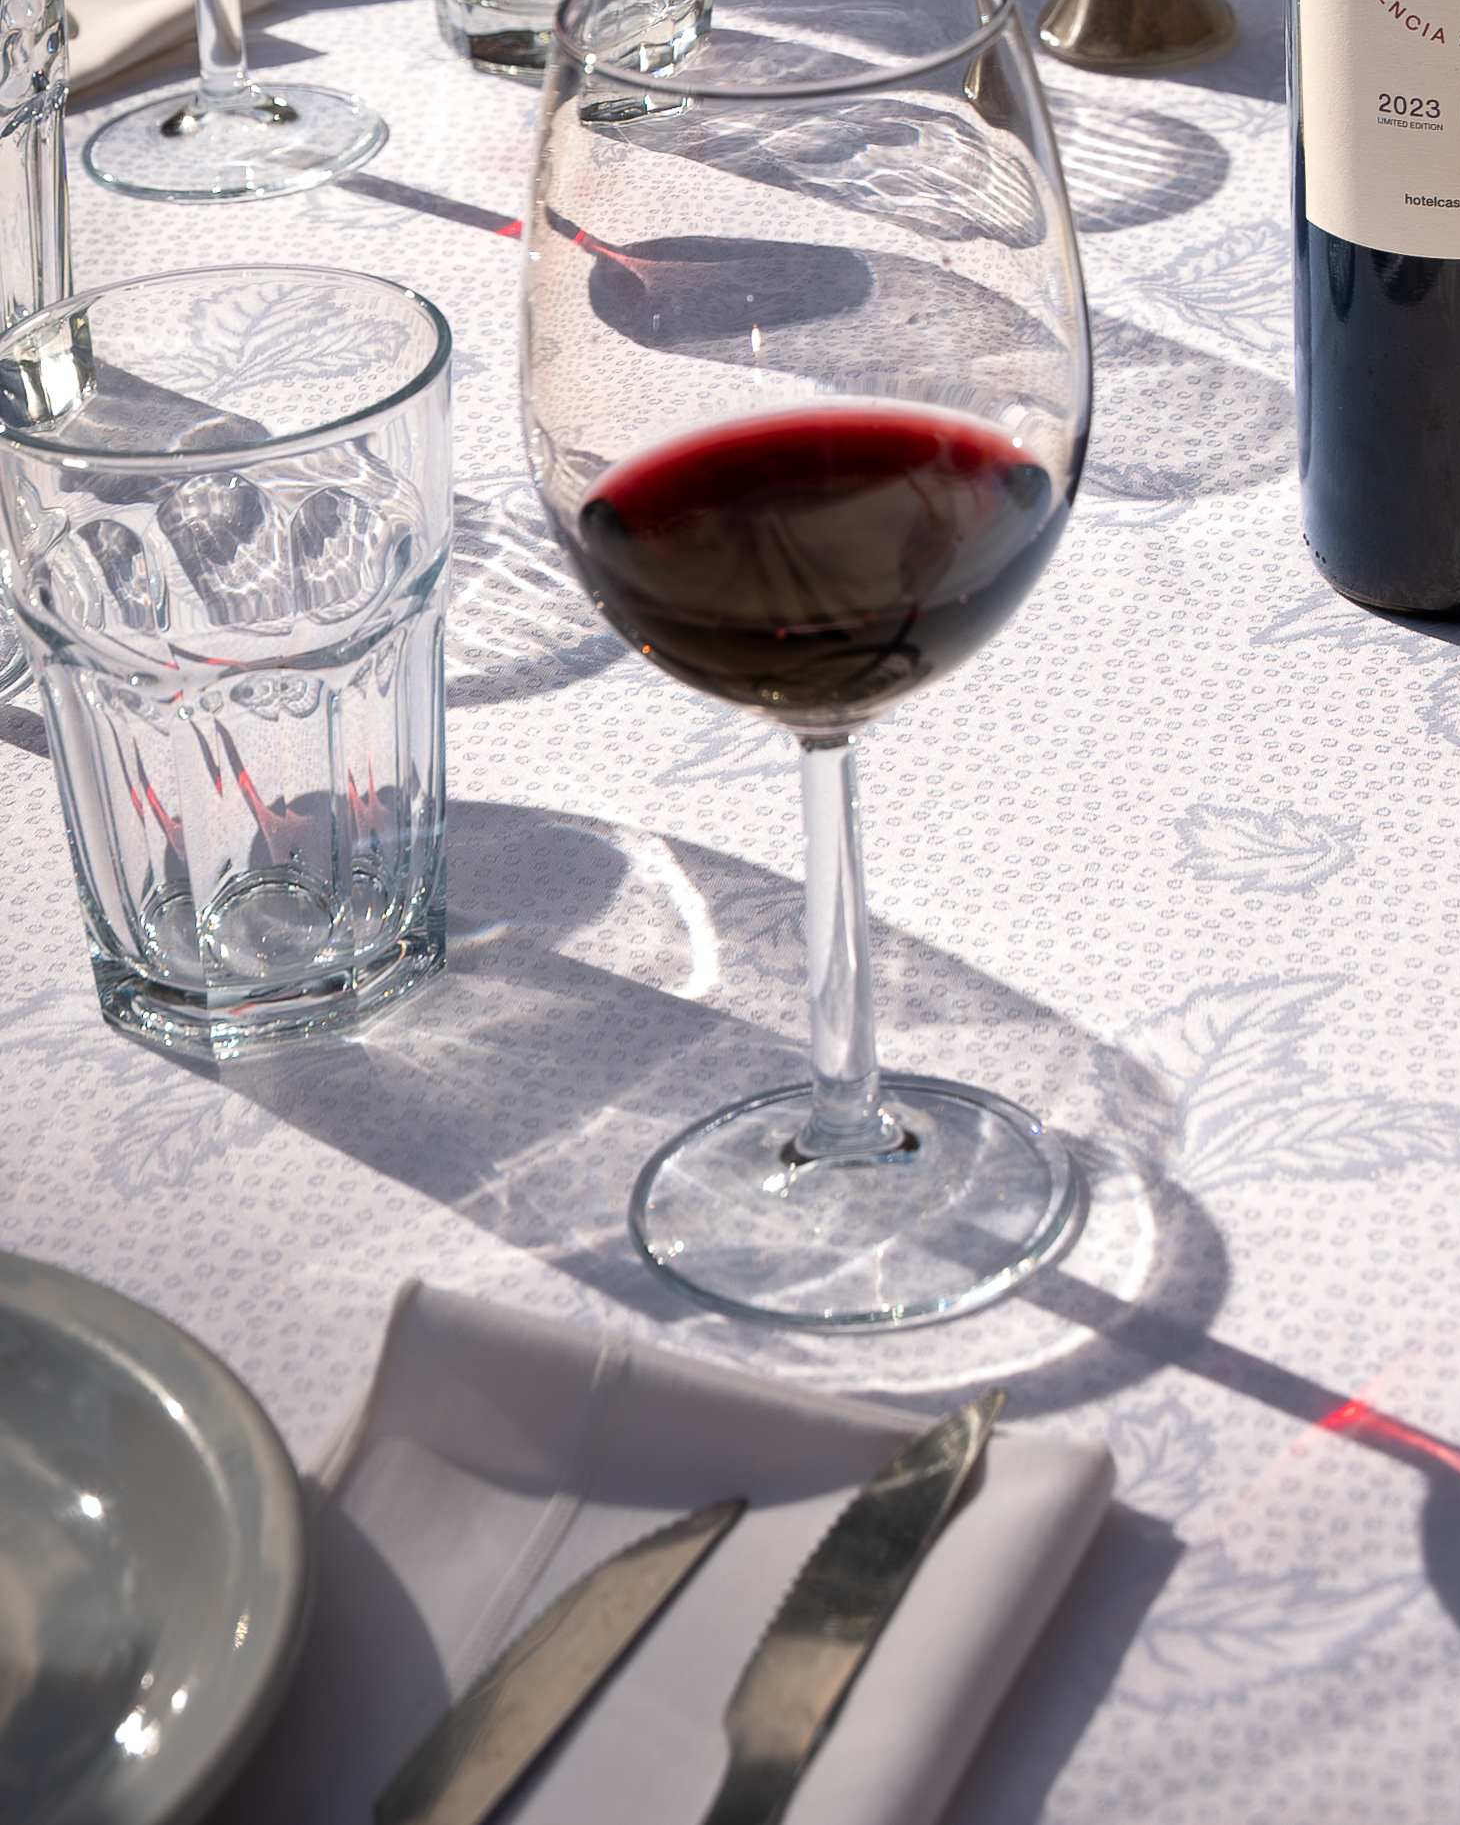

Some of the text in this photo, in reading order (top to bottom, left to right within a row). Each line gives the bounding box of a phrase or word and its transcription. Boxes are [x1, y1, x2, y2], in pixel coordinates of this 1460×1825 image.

[1378, 93, 1441, 119] 2023
[1377, 117, 1443, 131] LIMITED EDITION
